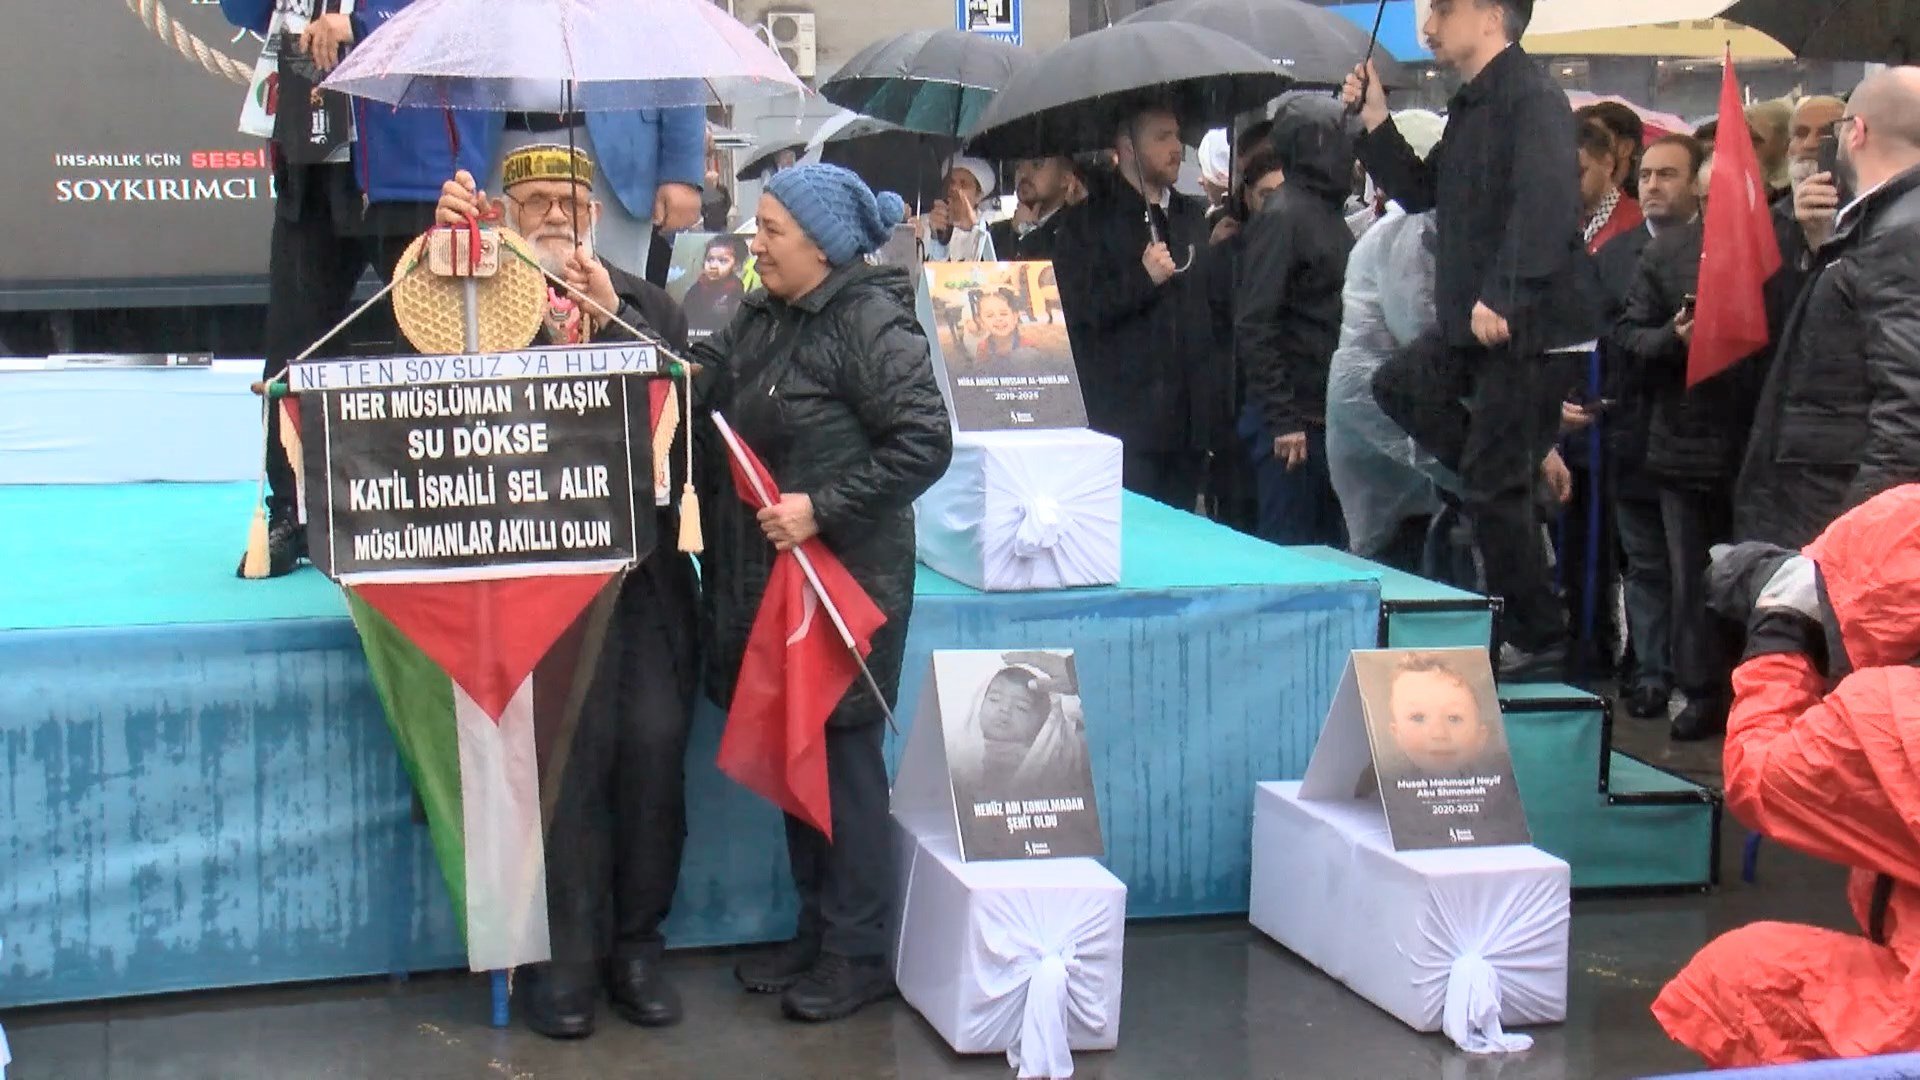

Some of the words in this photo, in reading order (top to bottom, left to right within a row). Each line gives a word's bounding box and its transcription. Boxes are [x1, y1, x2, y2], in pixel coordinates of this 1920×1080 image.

[191, 148, 265, 168] SESSİ
[56, 177, 256, 201] SOYKIRIMCI
[340, 392, 386, 420] HER
[391, 384, 512, 418] MÜSLÜMAN
[524, 383, 536, 411] 1
[543, 379, 611, 415] KAŞIK
[408, 429, 444, 459] SU
[453, 420, 548, 458] DÖKSE
[350, 469, 414, 511] KATİL
[418, 465, 496, 508] İSRAİLİ
[508, 469, 549, 503] SEL
[560, 465, 610, 500] ALIR
[354, 519, 495, 560] MÜSLÜMANLAR
[498, 519, 557, 552] AKILLI
[561, 520, 611, 548] OLUN
[1417, 788, 1436, 798] Abu
[1429, 777, 1475, 788] Mahmoud
[974, 800, 1004, 818] HENÜZ
[1005, 800, 1021, 815] ADI
[1022, 797, 1084, 813] KONULMADAN
[1006, 813, 1032, 834] ŞEHİT
[1033, 813, 1058, 829] OLDU
